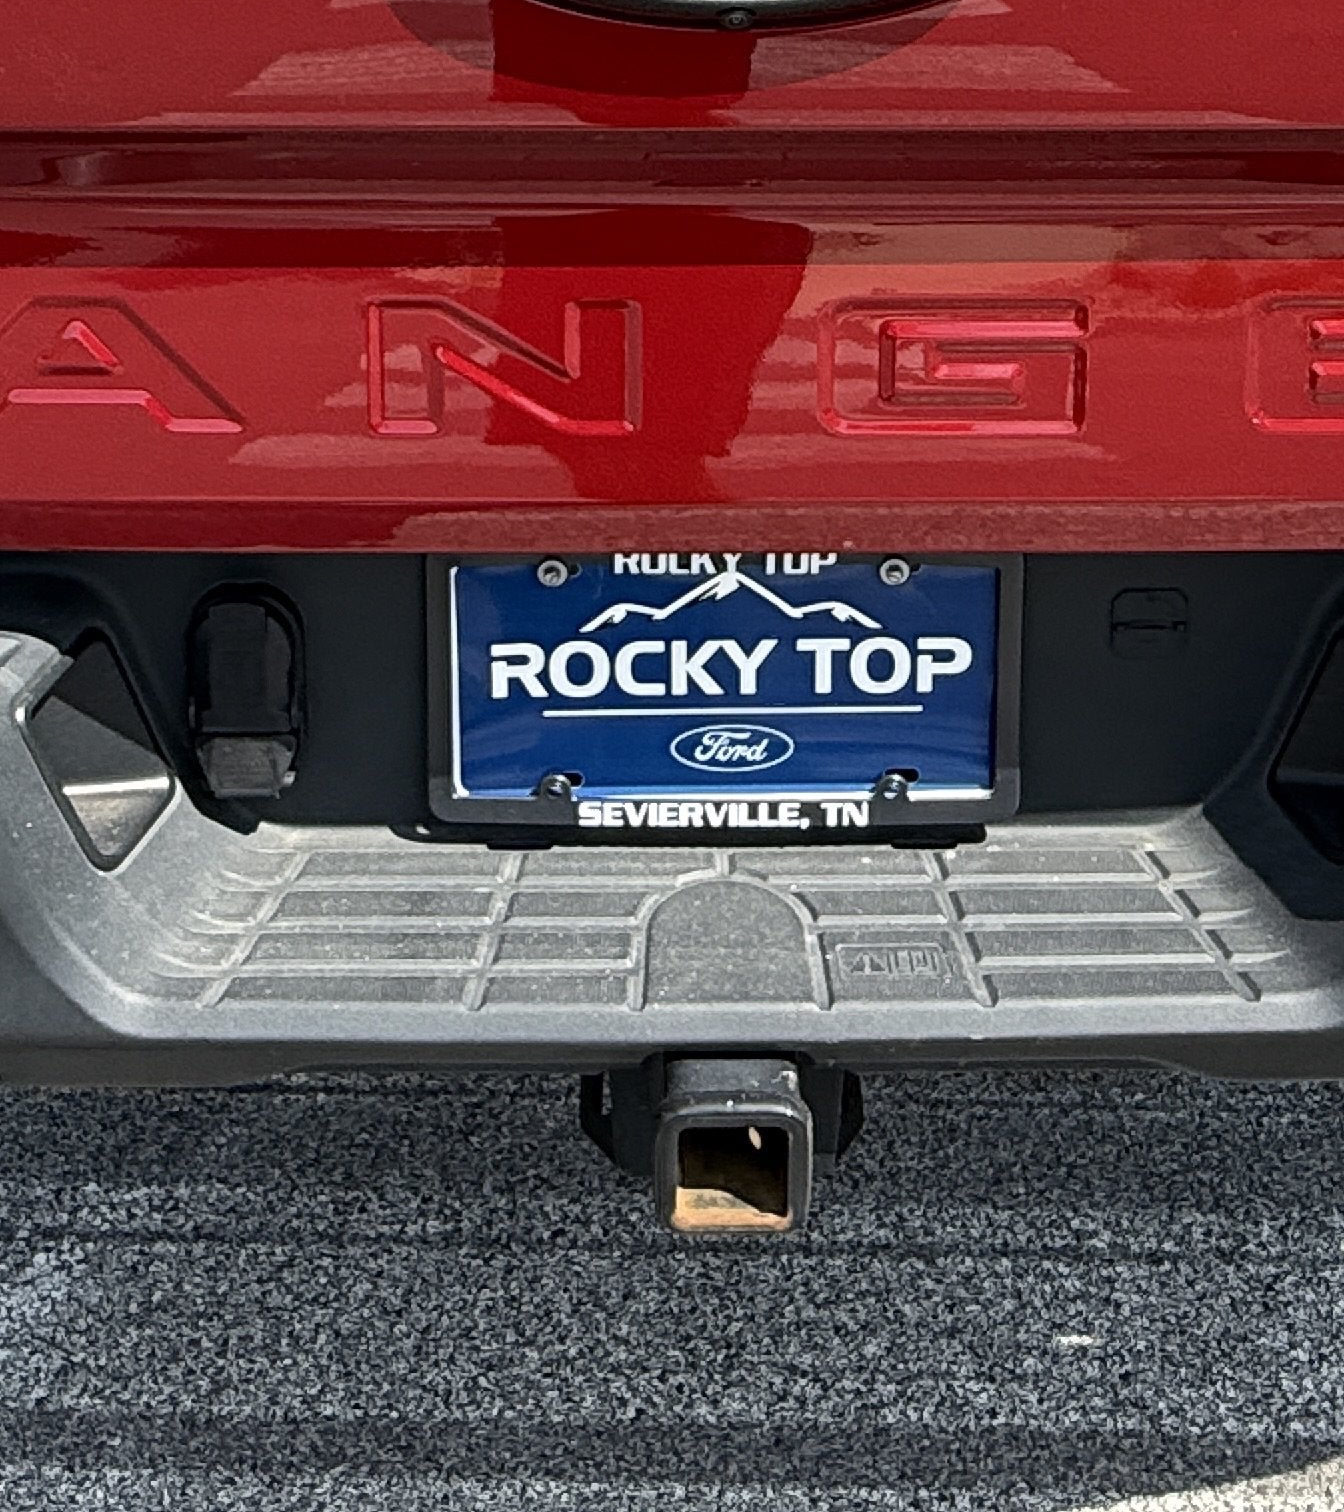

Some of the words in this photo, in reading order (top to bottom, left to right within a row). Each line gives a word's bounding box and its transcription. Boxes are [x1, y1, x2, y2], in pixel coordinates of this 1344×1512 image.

[490, 638, 779, 699] ROCKY
[796, 636, 973, 694] TOP
[694, 730, 769, 764] Ford
[577, 801, 811, 829] SEVIERVILLE,
[824, 801, 869, 828] TN
